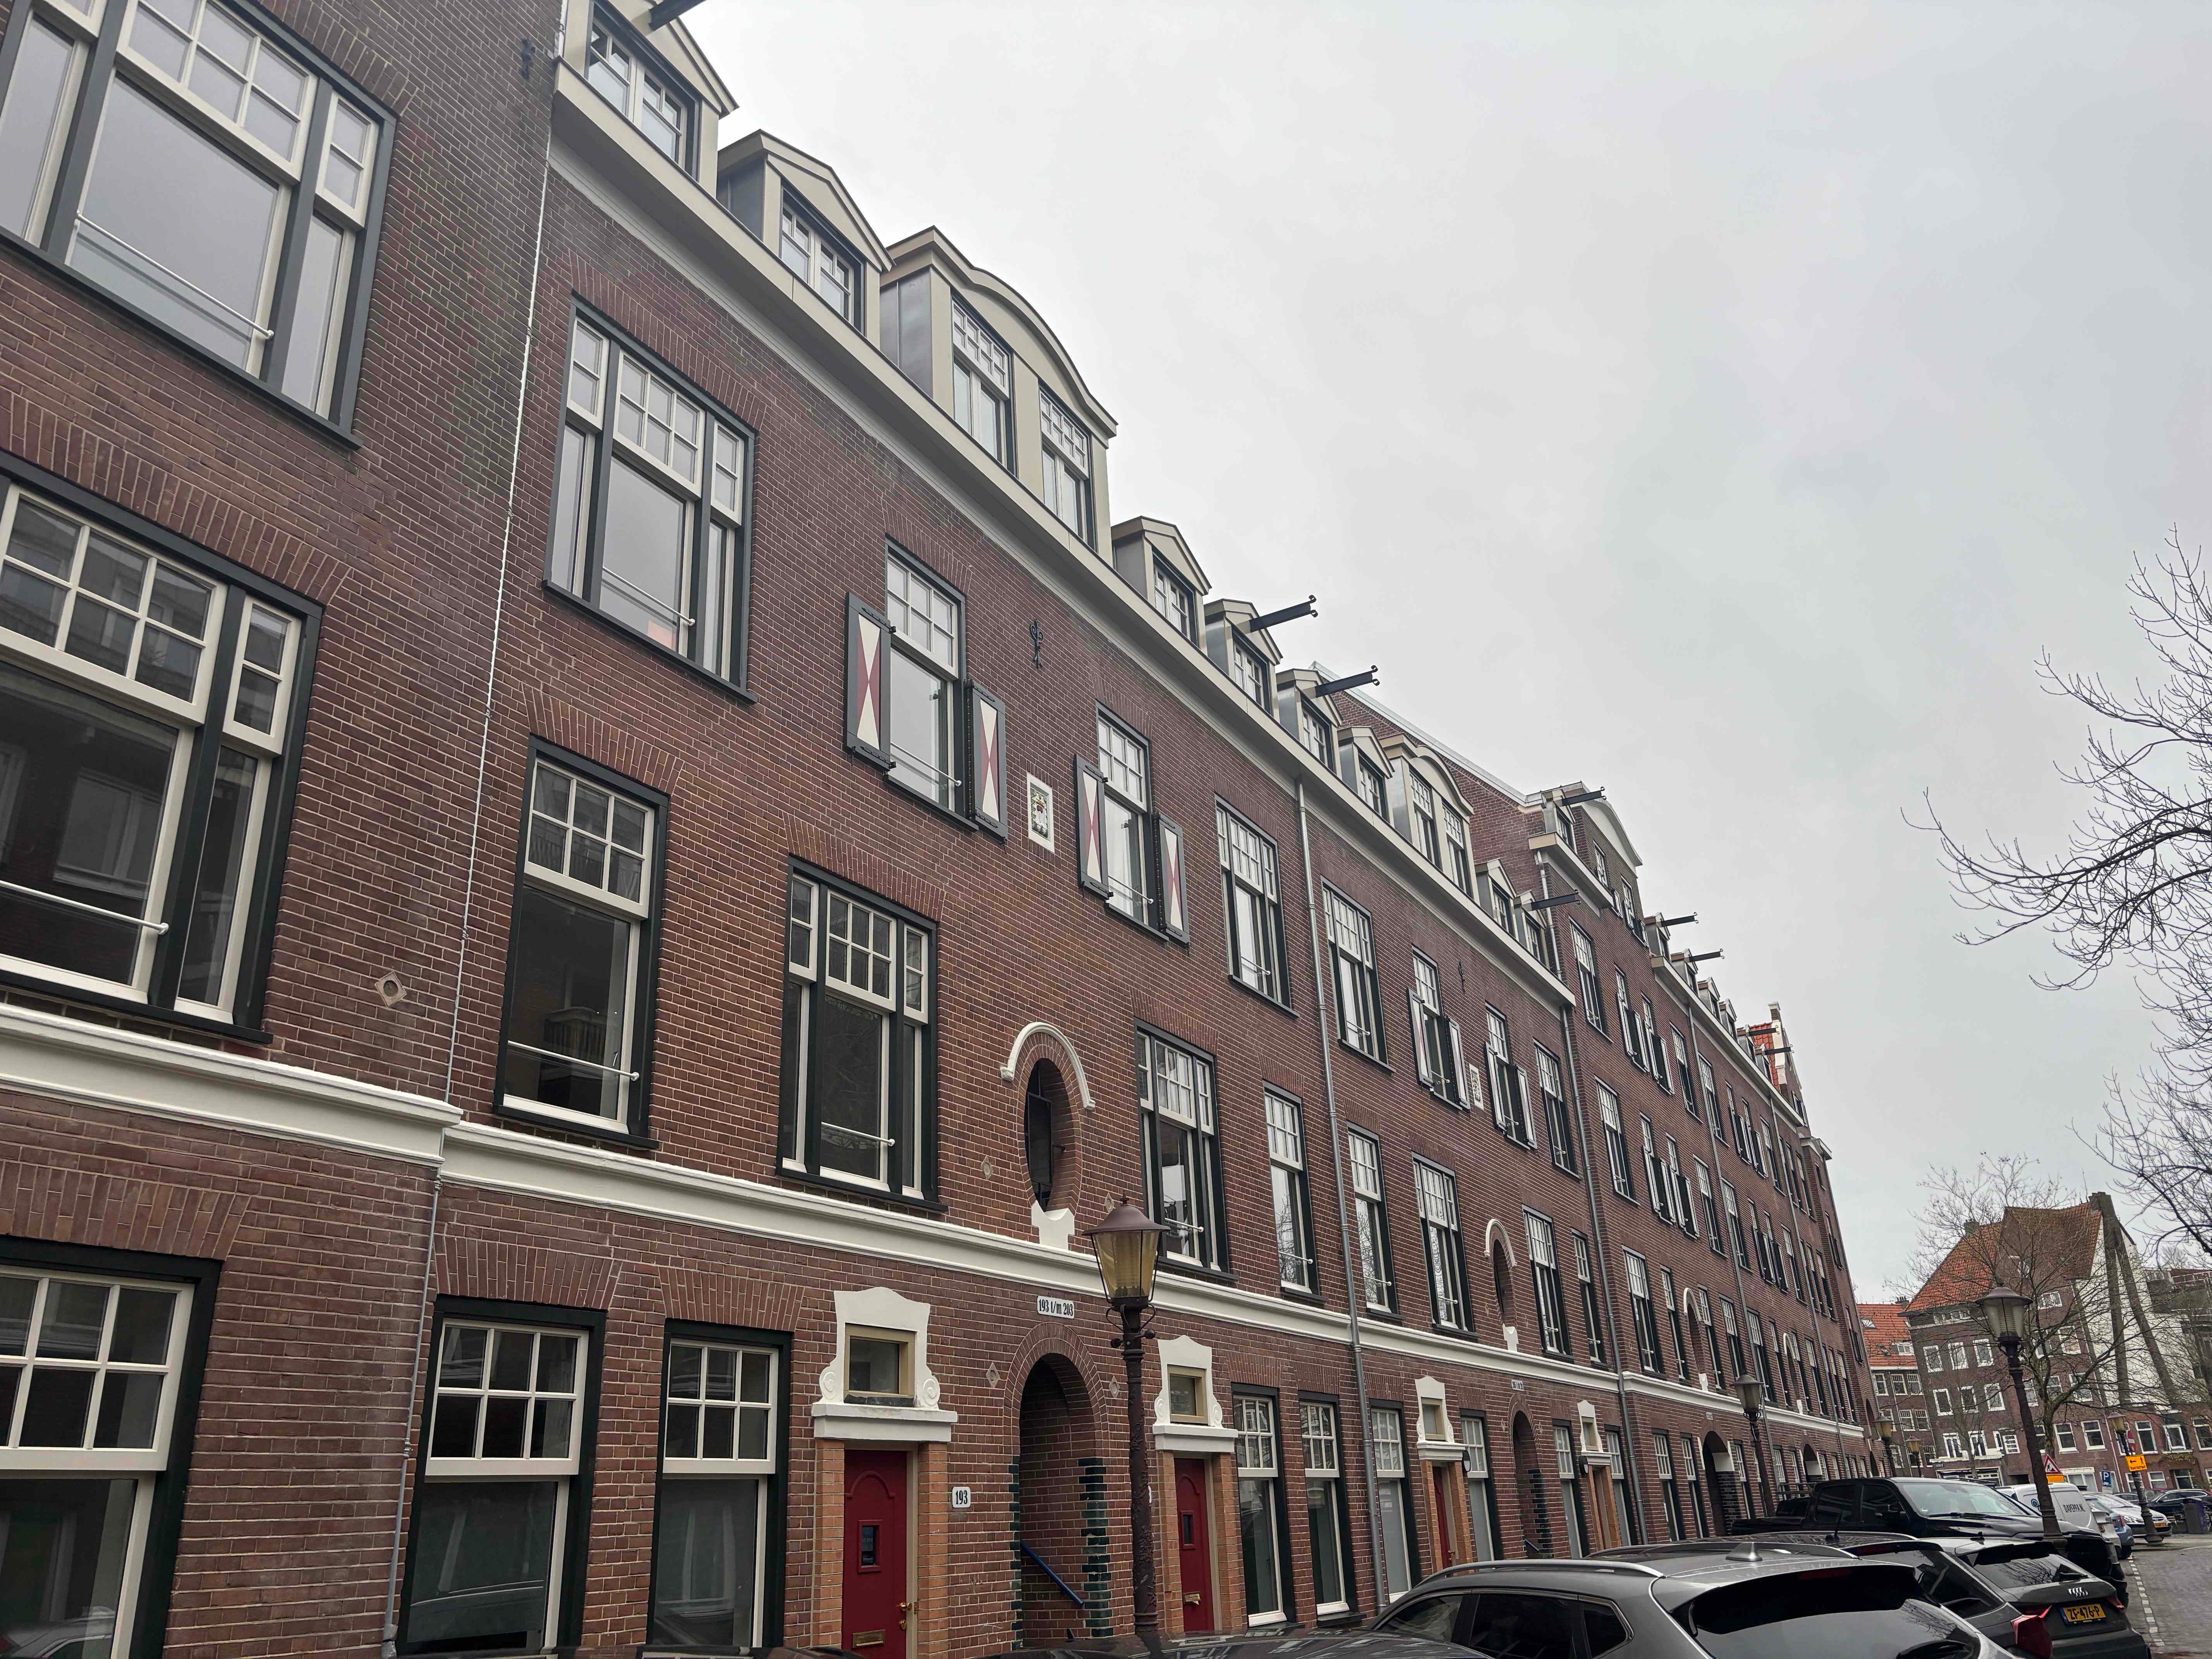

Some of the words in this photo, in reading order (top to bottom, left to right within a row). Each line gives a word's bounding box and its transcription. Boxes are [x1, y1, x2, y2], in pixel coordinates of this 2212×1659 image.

[1039, 1299, 1049, 1312] 193
[1051, 1301, 1061, 1314] t/m
[1063, 1303, 1073, 1316] 203
[2103, 1472, 2109, 1480] P
[955, 1490, 967, 1504] 193
[2067, 1606, 2099, 1620] ZF-476-P
